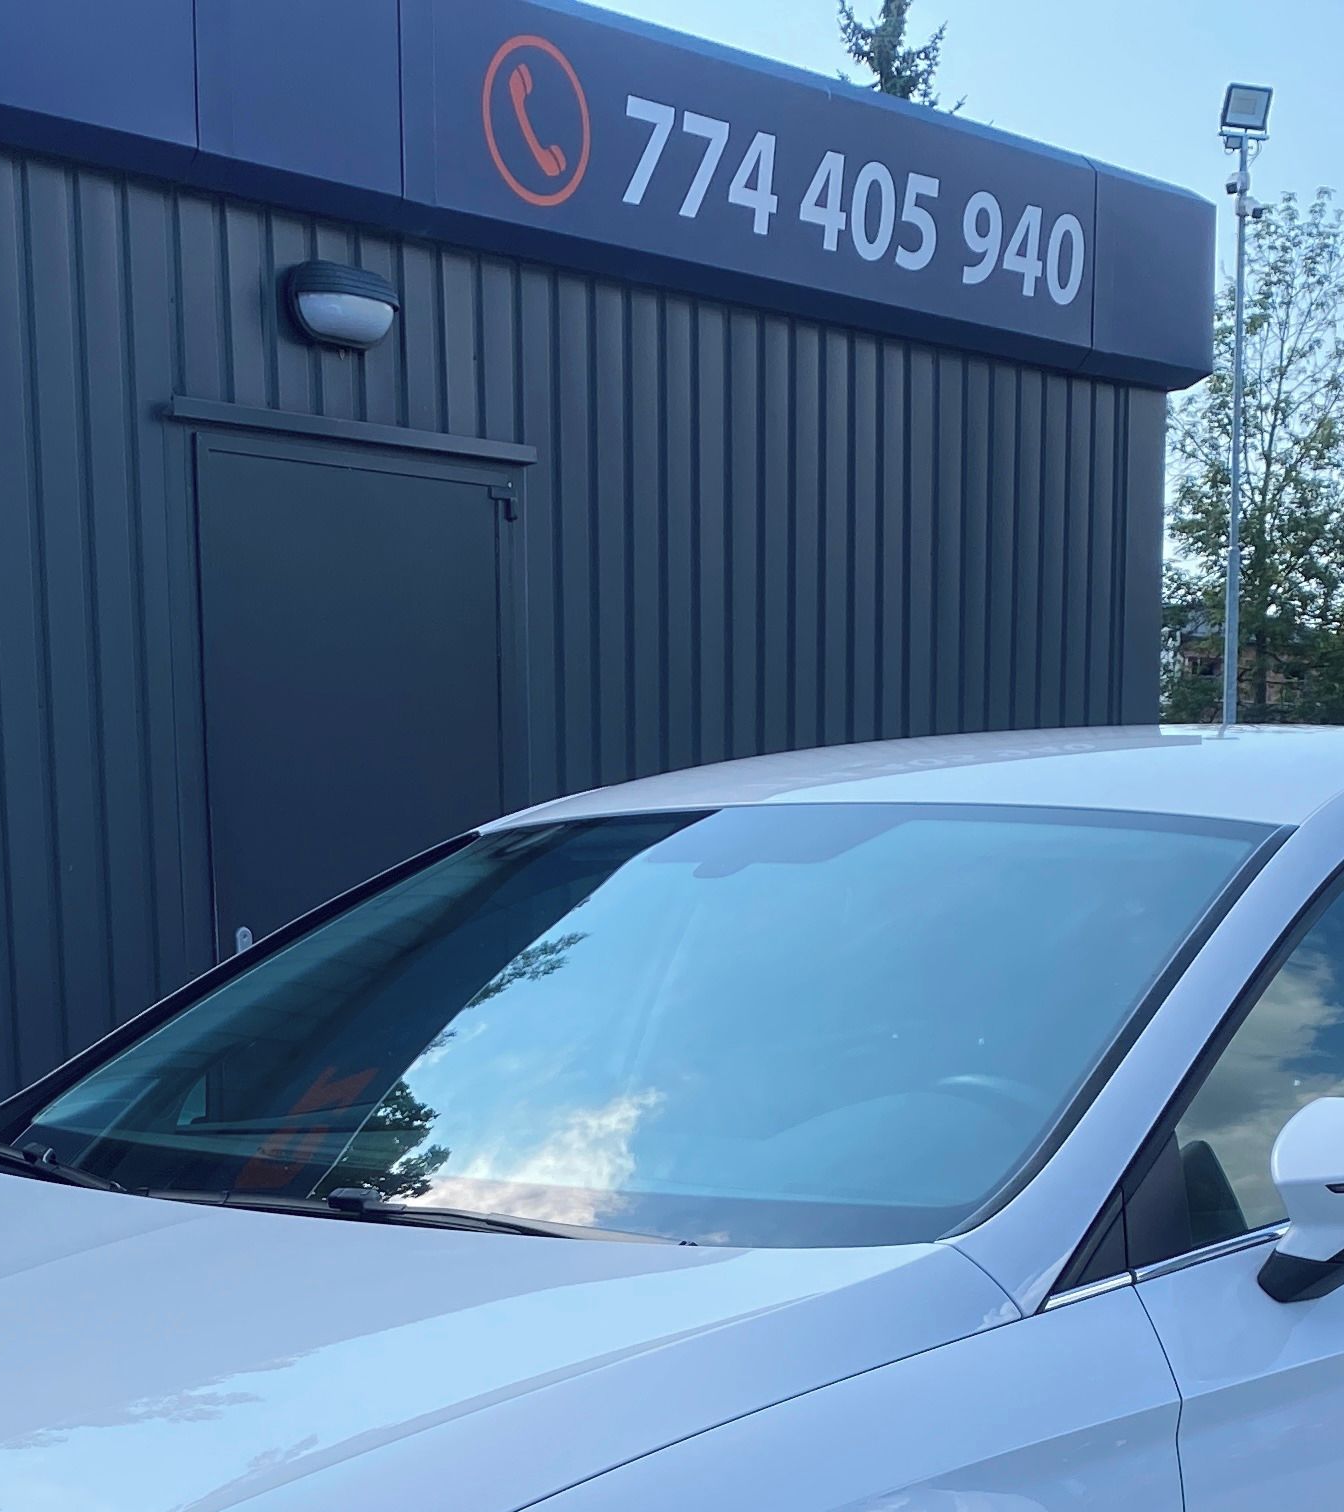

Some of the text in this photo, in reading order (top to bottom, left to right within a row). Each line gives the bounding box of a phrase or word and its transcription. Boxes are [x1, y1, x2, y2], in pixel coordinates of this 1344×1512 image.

[622, 94, 1086, 306] 774 405 940
